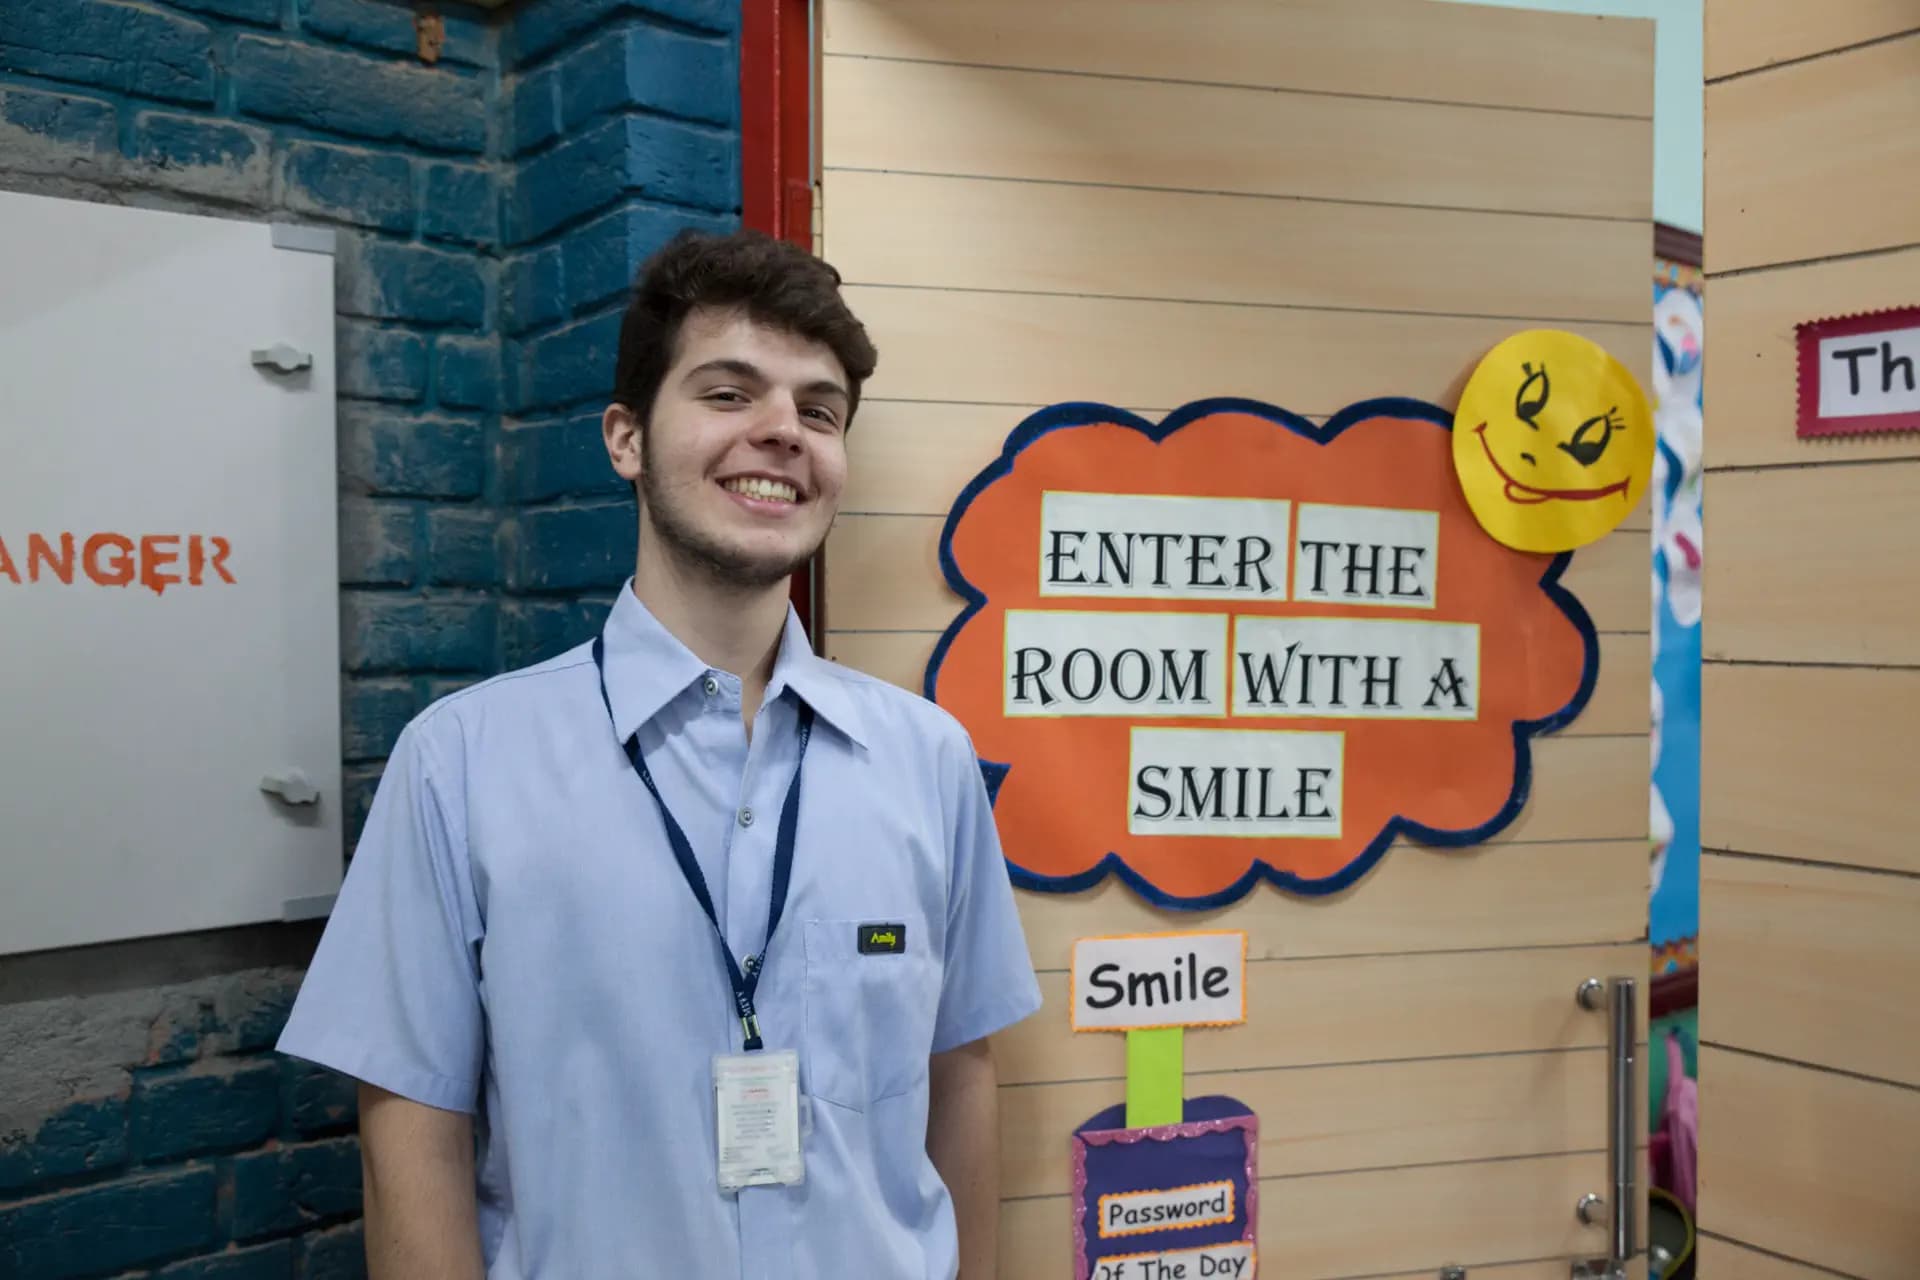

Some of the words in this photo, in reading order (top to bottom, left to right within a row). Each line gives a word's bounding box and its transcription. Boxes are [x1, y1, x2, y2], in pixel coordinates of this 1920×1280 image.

[1832, 341, 1916, 395] Th
[1045, 530, 1277, 593] ENTER
[1300, 541, 1428, 597] THE
[1011, 647, 1212, 706] ROOM
[1238, 641, 1401, 708] WITH
[1422, 658, 1474, 709] A
[1133, 766, 1335, 821] SMILE
[1086, 952, 1230, 1009] Smile
[1109, 1190, 1226, 1227] Password
[1137, 1259, 1187, 1280] The
[1200, 1253, 1247, 1279] Day
